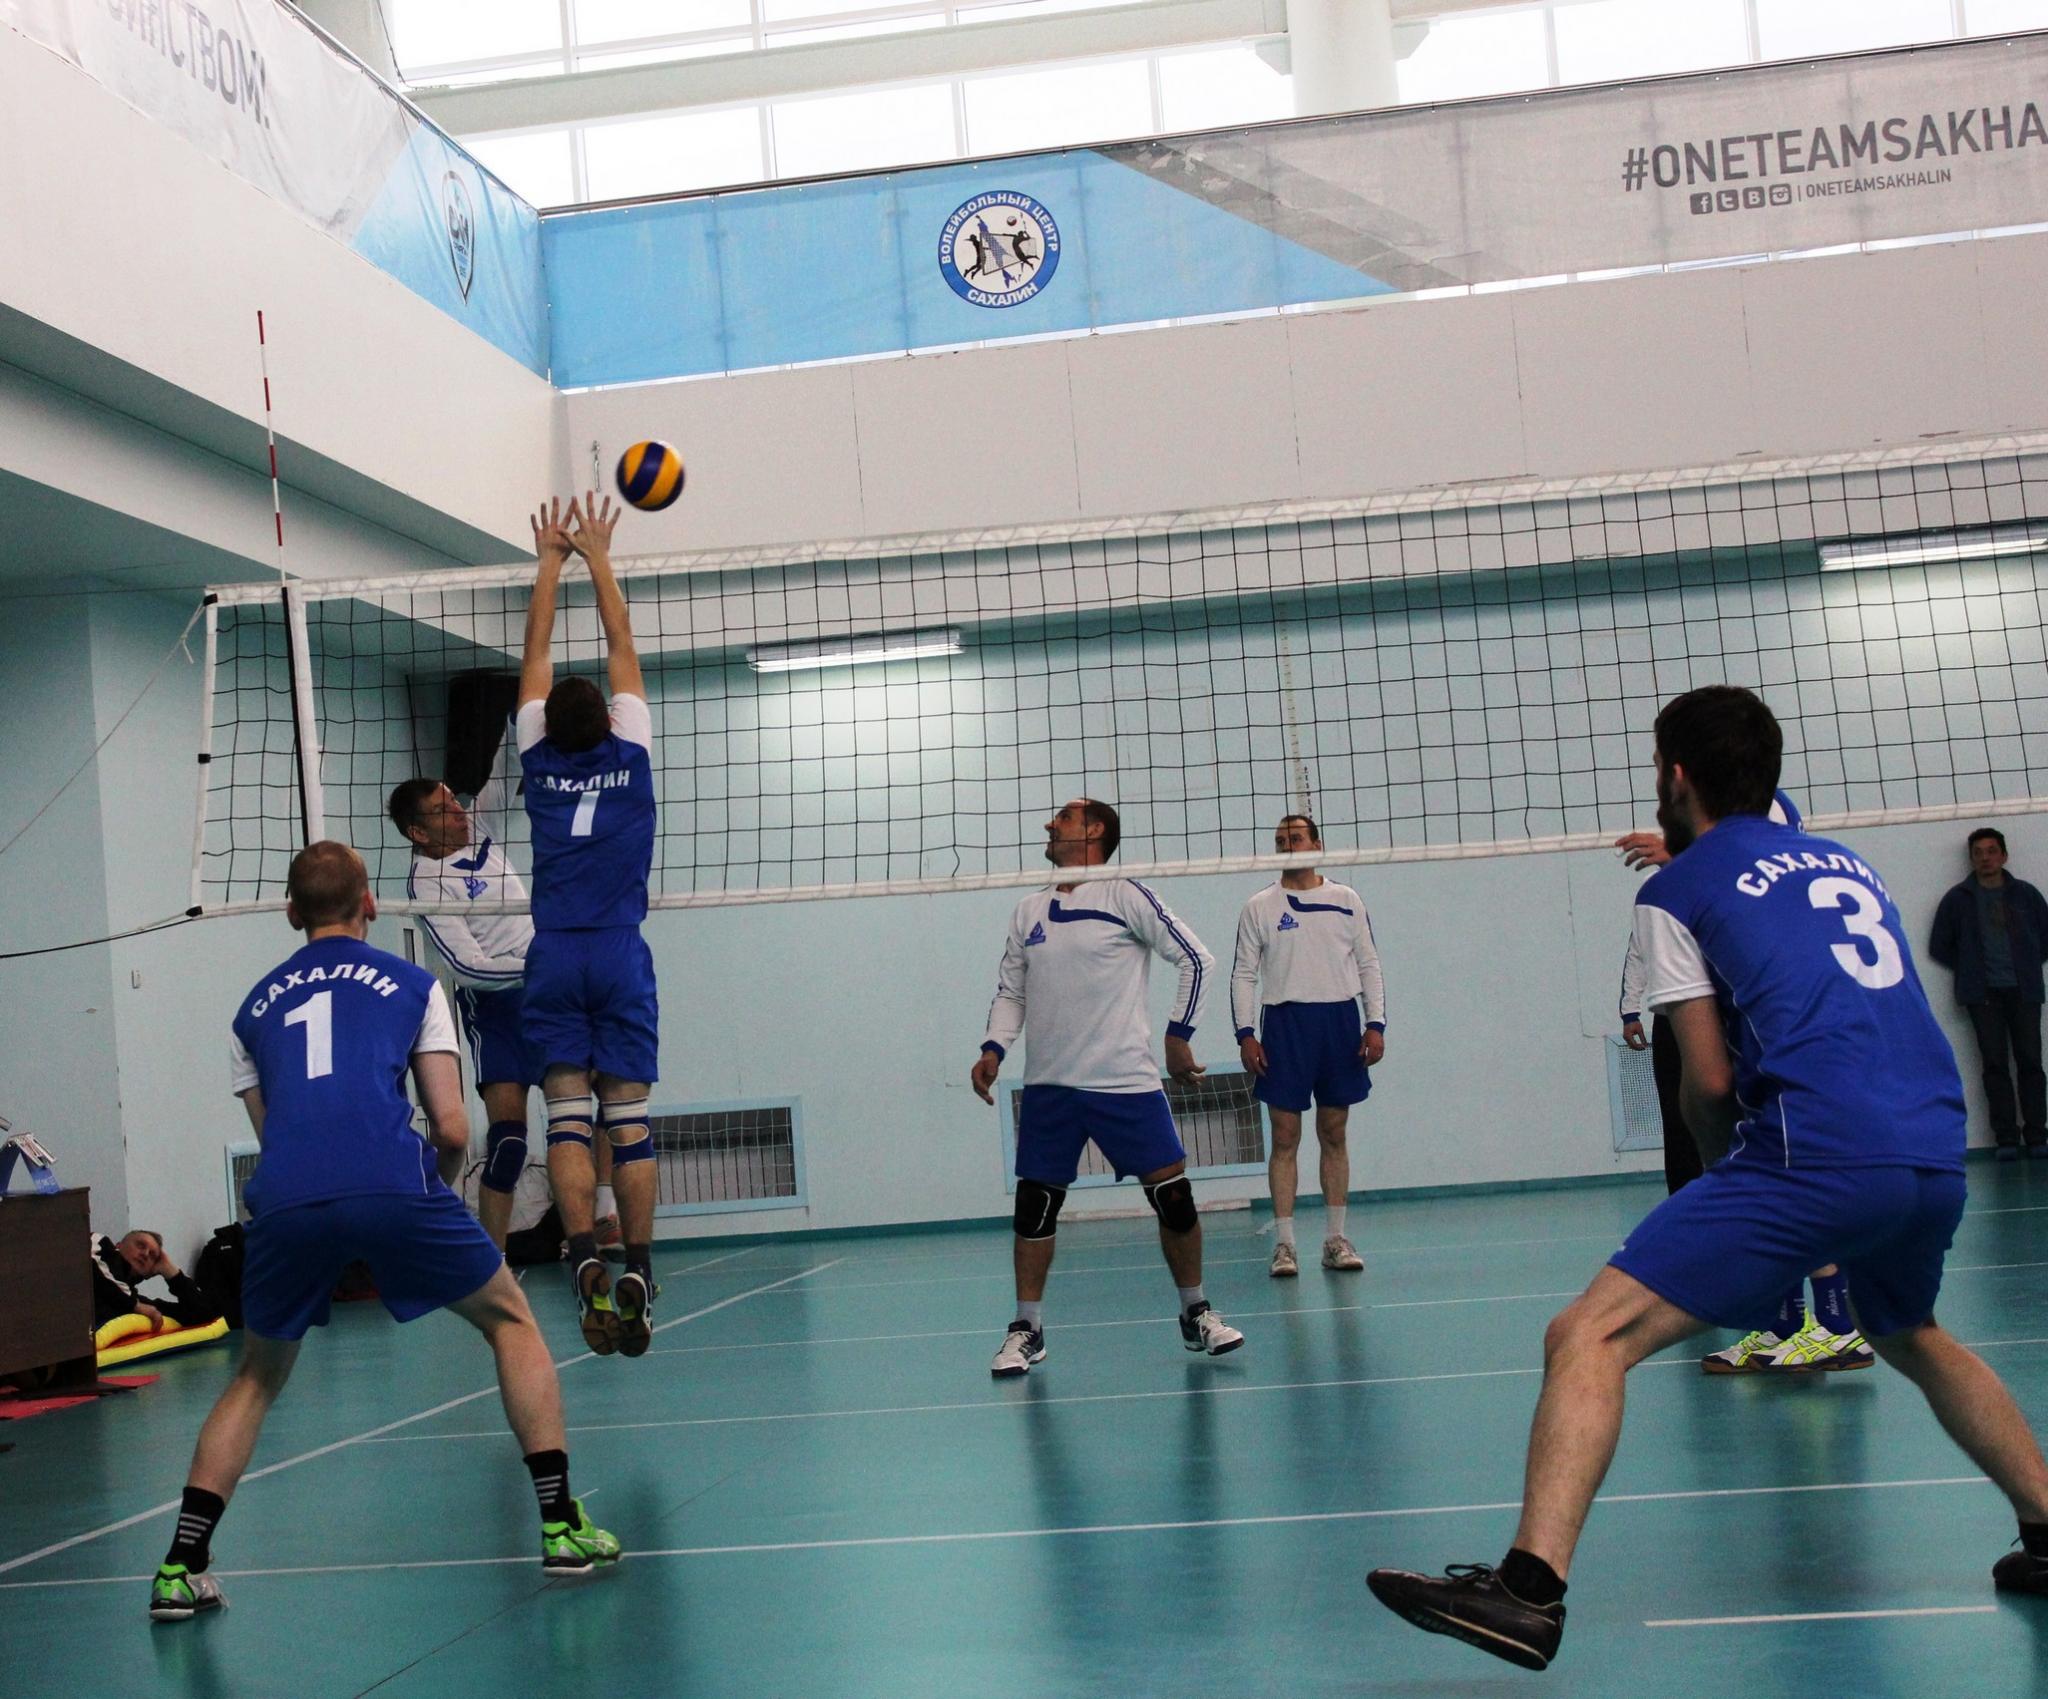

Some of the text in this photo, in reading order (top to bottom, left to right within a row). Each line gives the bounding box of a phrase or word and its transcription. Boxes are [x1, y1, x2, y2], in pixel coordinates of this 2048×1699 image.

[1621, 101, 2048, 192] #ONETEAMSAKHA
[1806, 168, 1952, 199] ONETEAMSAKHALIN
[940, 192, 1058, 264] ВОЛЕЙБОЛЬНЫЙ ЦЕНТР
[967, 281, 1039, 307] САХАЛИН
[1808, 876, 1904, 990] 3
[250, 963, 400, 1018] САХАЛИН
[283, 989, 333, 1080] 1
